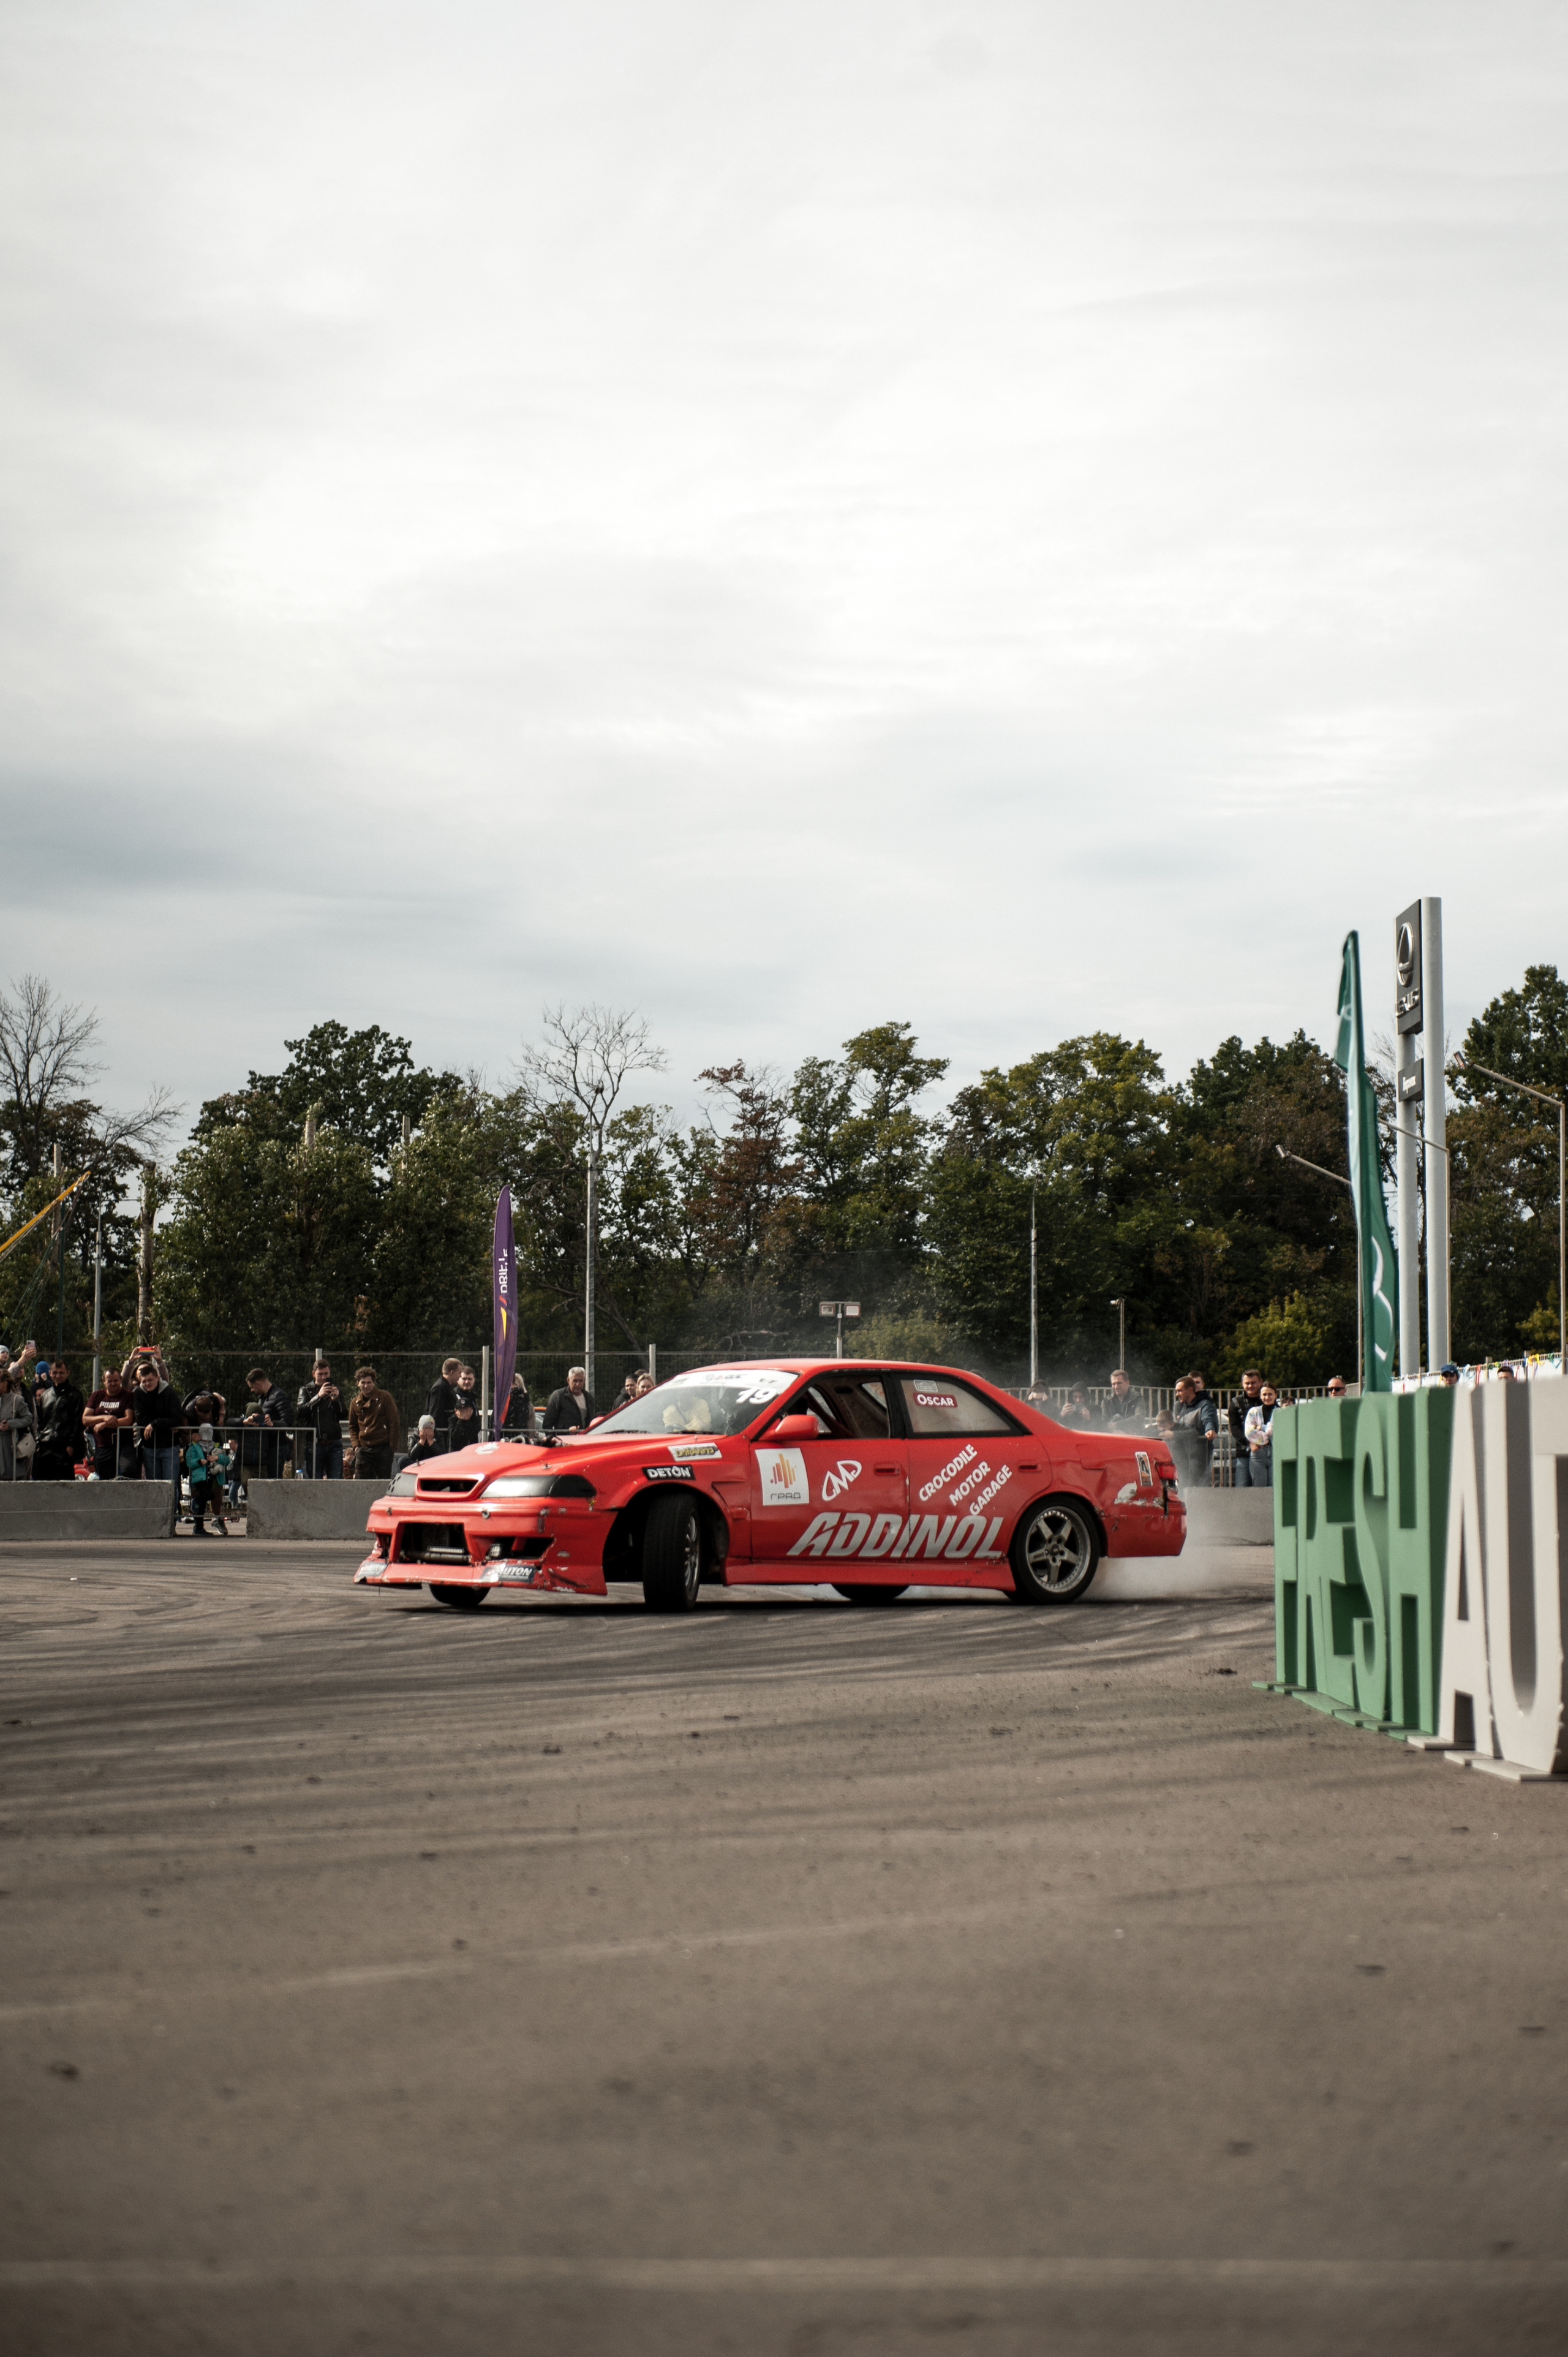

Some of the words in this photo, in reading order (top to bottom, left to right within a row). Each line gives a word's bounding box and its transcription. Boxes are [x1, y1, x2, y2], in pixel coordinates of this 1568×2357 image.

[736, 1387, 777, 1404] 19
[917, 1394, 955, 1406] OSCAR
[647, 1466, 692, 1478] DETON
[919, 1443, 978, 1501] CROCODILE
[949, 1461, 990, 1506] MOTOR
[970, 1464, 1012, 1515] GARAGE
[786, 1511, 1005, 1558] ADDINOL
[1273, 1391, 1438, 1735] FRESH
